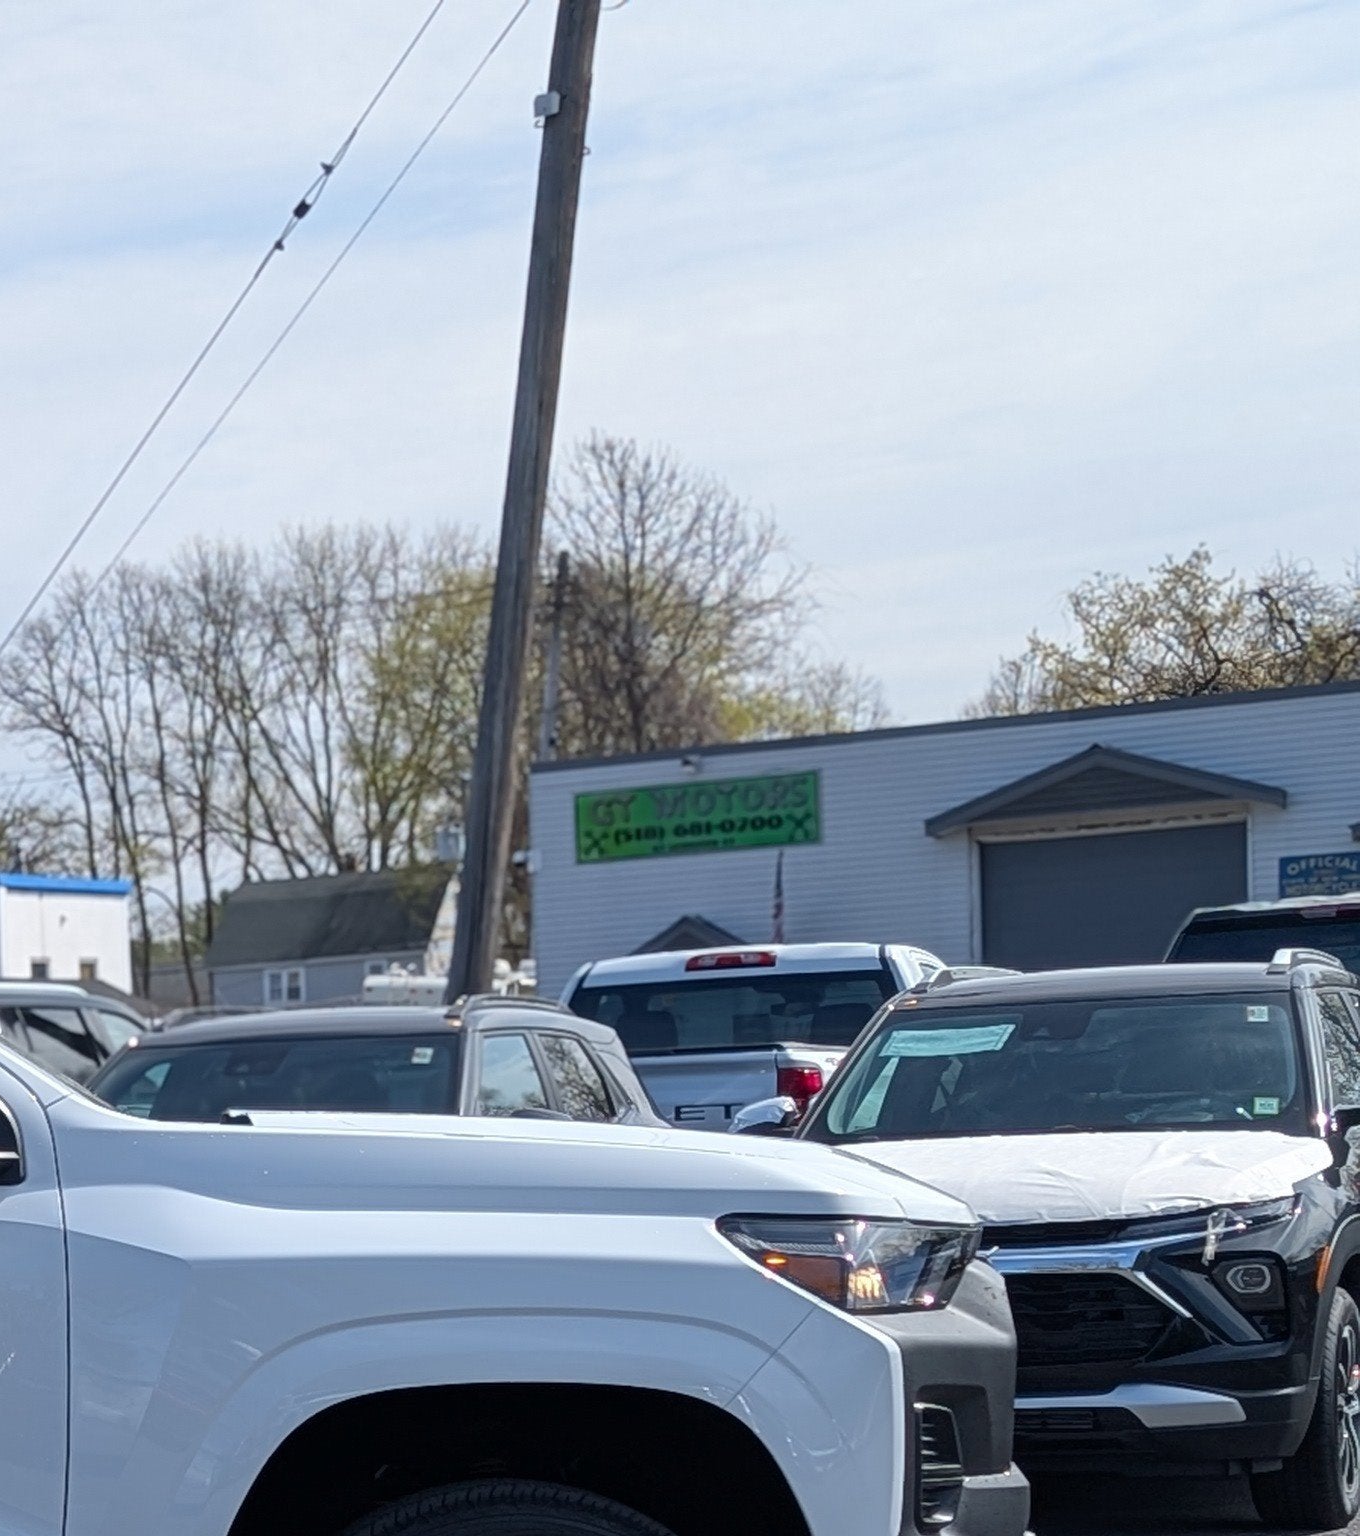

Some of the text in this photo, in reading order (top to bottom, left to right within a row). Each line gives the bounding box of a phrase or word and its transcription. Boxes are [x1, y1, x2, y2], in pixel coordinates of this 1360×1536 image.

[650, 778, 809, 819] MOTORS
[613, 825, 666, 846] (518)
[673, 814, 784, 838] 681-0700
[1286, 856, 1358, 876] OFFICIAL
